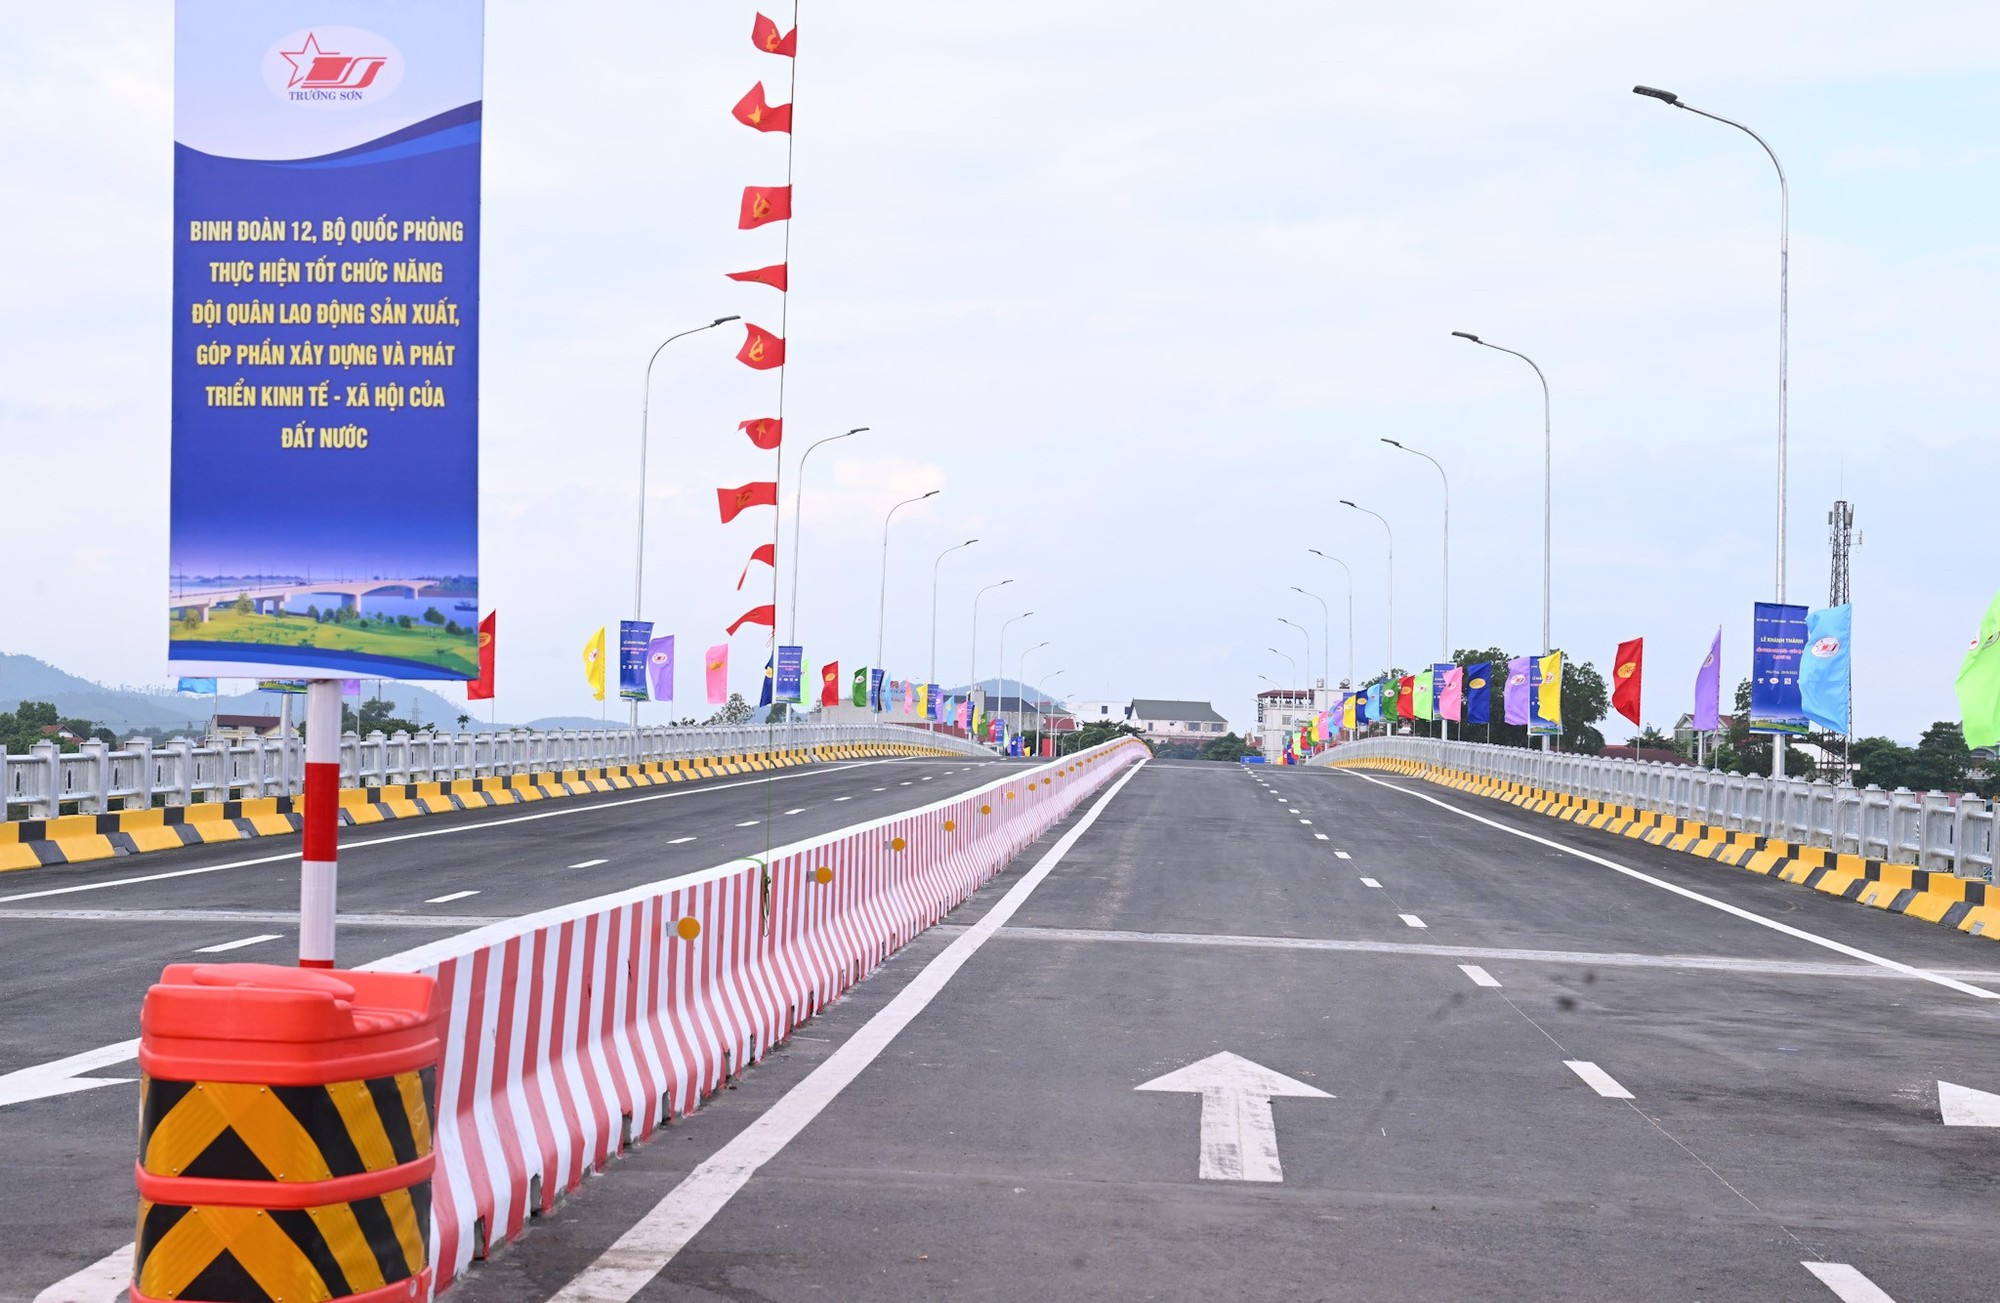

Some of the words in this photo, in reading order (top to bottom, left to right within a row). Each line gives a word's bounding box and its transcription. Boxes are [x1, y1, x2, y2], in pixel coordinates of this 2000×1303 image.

[289, 88, 337, 101] TRƯỜNG
[340, 90, 363, 101] SƠN
[190, 220, 232, 242] BINH
[238, 216, 285, 242] ĐOÀN
[291, 220, 317, 244] 12,
[322, 216, 346, 247] BỘ
[351, 213, 398, 244] QUỐC
[403, 215, 464, 242] PHÒNG
[209, 259, 254, 287] THỰC
[259, 257, 301, 287] HIỆN
[305, 255, 337, 283] TỐT
[341, 256, 388, 283] CHỨC
[394, 257, 443, 284] NĂNG
[191, 299, 222, 329] ĐỘI
[227, 298, 275, 327] QUÂN
[280, 303, 312, 325] LAO
[317, 299, 366, 329] ĐỘNG
[370, 296, 406, 325] SẢN
[411, 296, 459, 327] XUẤT,
[196, 340, 231, 366] GÓP
[237, 336, 284, 366] PHẦN
[290, 340, 325, 366] XÂY
[329, 343, 377, 371] DỰNG
[382, 340, 406, 366] VÀ
[410, 340, 456, 366] PHÁT
[205, 378, 257, 407] TRIỂN
[261, 385, 303, 407] KINH
[308, 379, 329, 407] TẾ
[345, 382, 369, 407] XÃ
[375, 382, 404, 412] HỘI
[409, 379, 446, 408] CỦA
[280, 420, 315, 449] ĐẤT
[320, 422, 368, 449] NƯỚC
